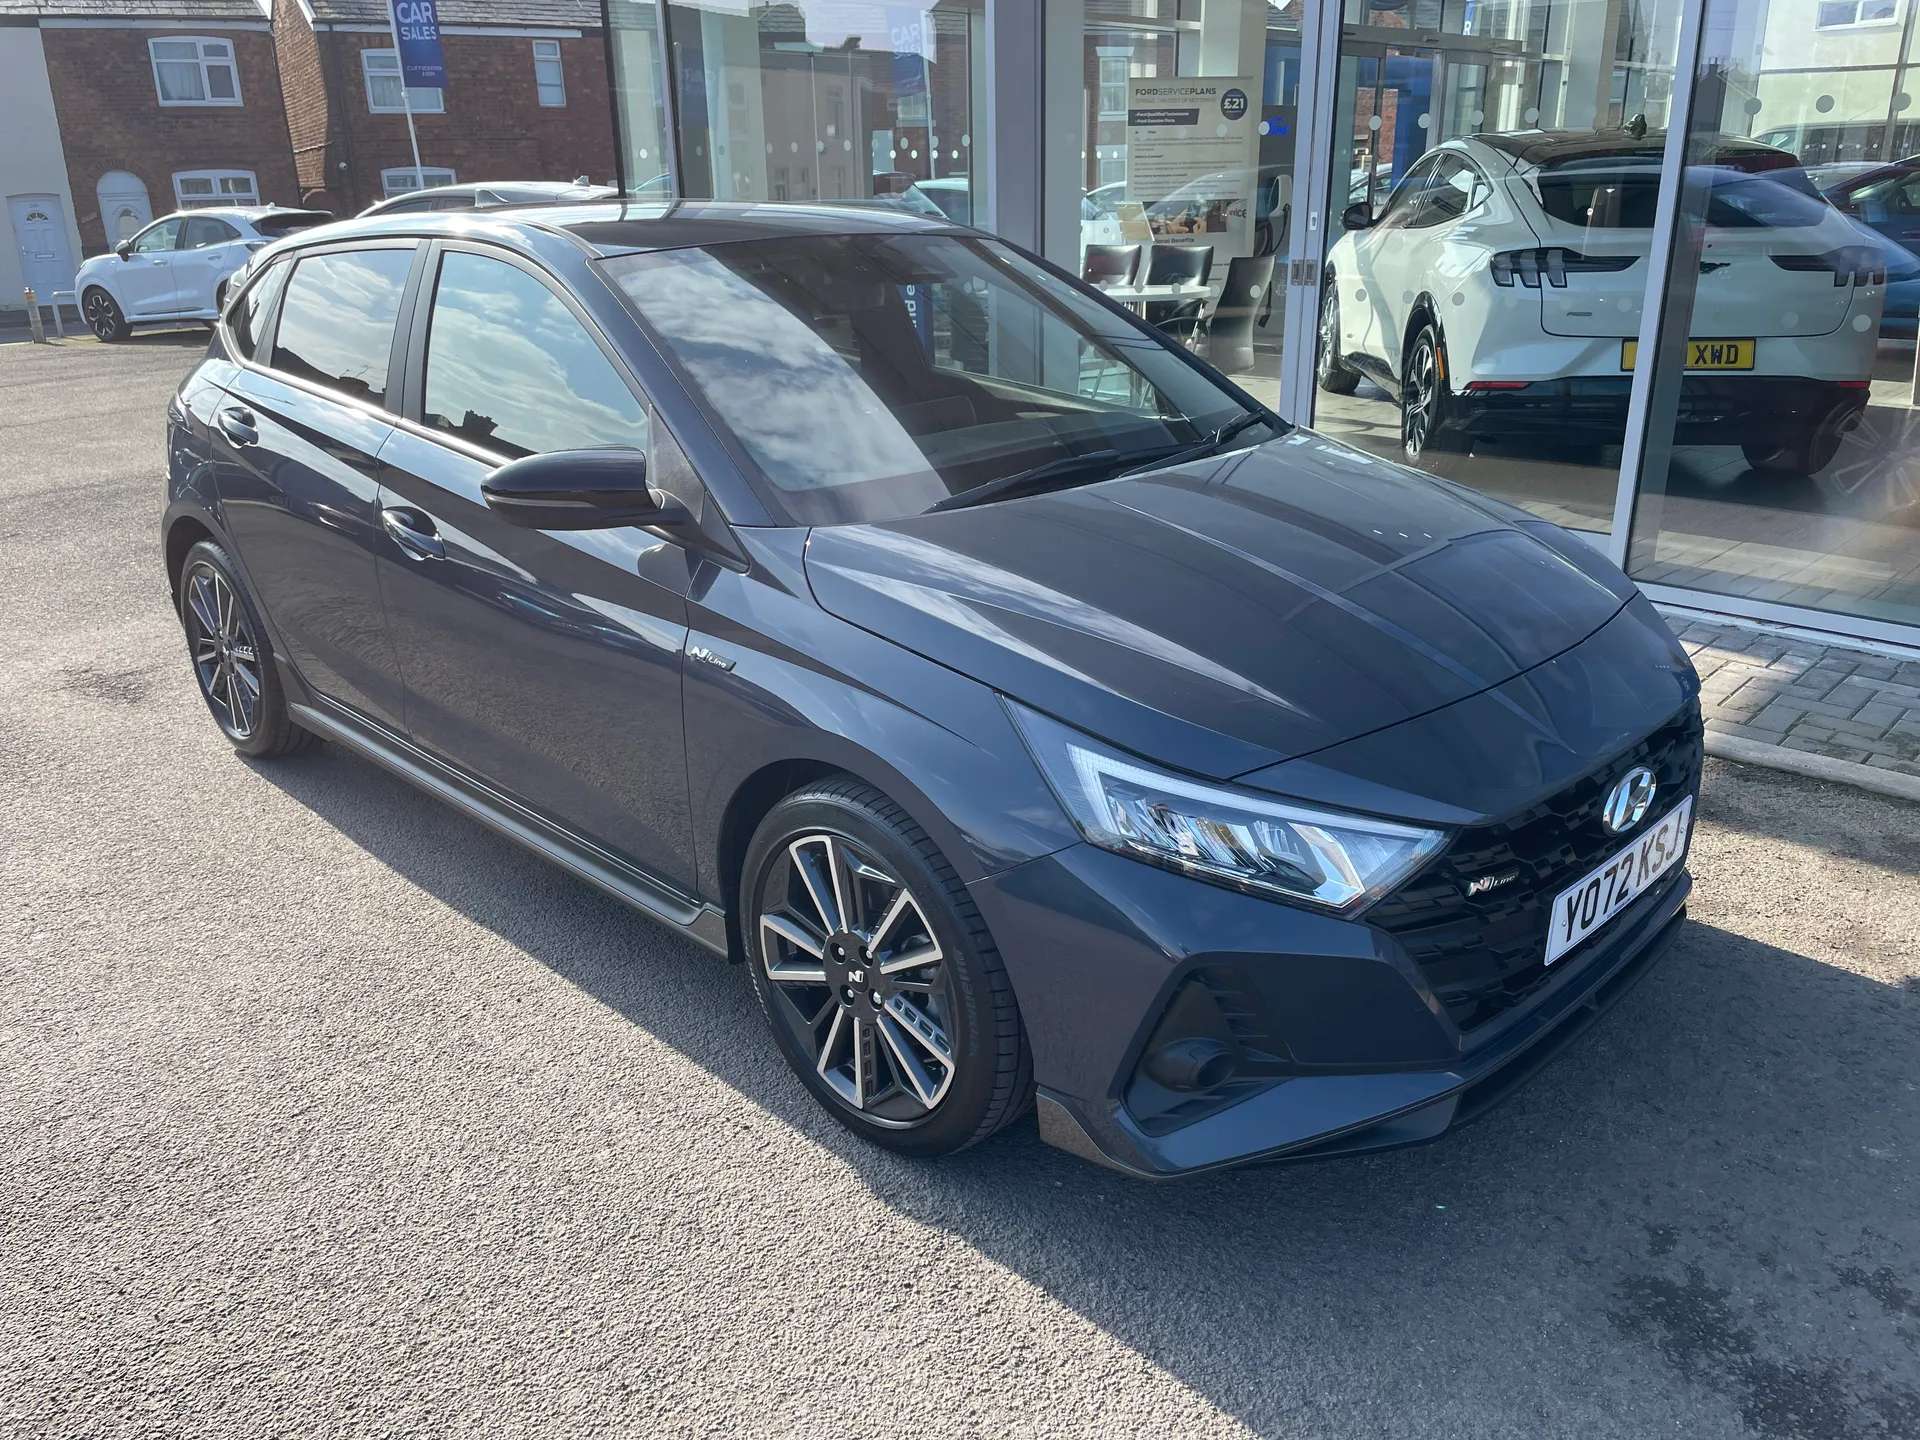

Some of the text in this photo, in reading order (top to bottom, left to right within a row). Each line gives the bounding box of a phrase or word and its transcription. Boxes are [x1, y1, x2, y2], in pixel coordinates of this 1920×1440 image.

[396, 2, 434, 24] CAR
[401, 26, 437, 40] SALES
[1223, 97, 1245, 109] £21
[1694, 344, 1740, 365] XWD
[1636, 810, 1683, 888] KSJ
